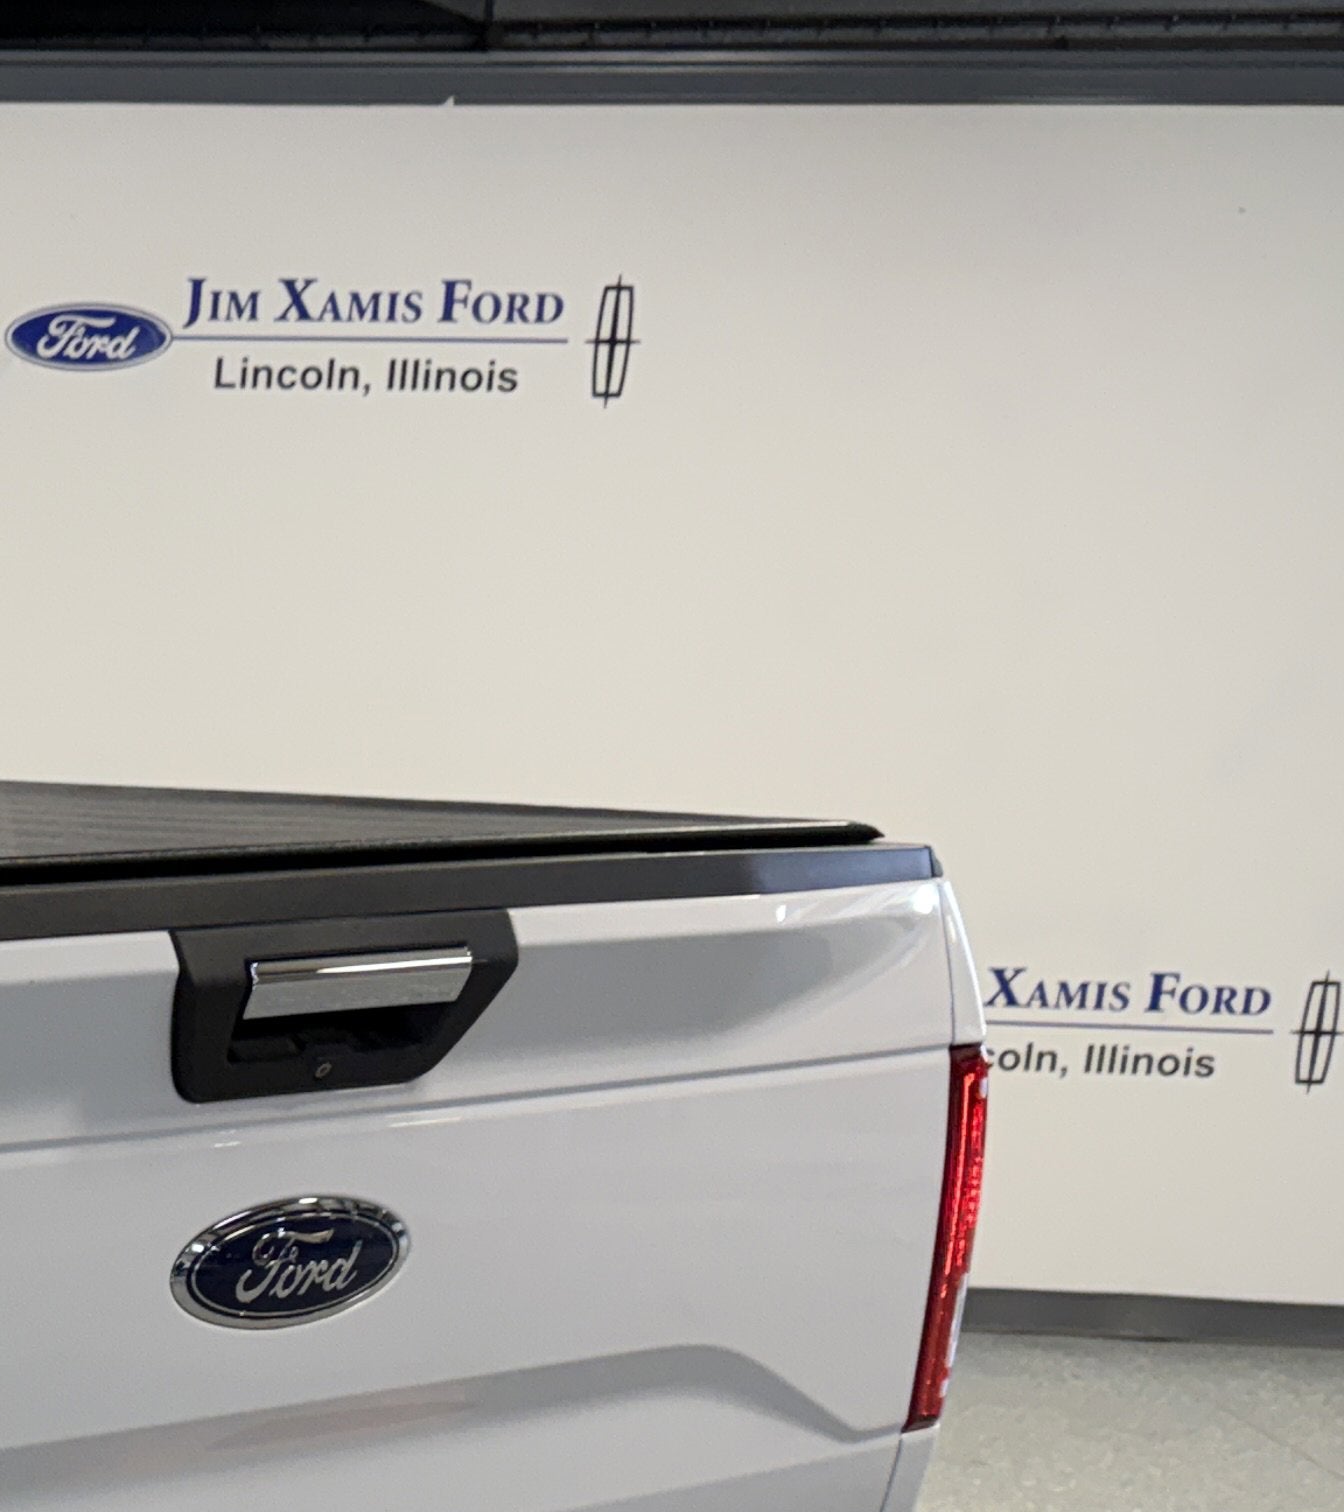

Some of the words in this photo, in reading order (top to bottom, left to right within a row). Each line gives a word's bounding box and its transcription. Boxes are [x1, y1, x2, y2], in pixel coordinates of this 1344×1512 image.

[35, 315, 136, 361] Ford
[214, 357, 372, 396] Lincoln,
[386, 358, 519, 393] Illinois
[1083, 1044, 1216, 1078] Illinois
[234, 1227, 362, 1304] Ford
